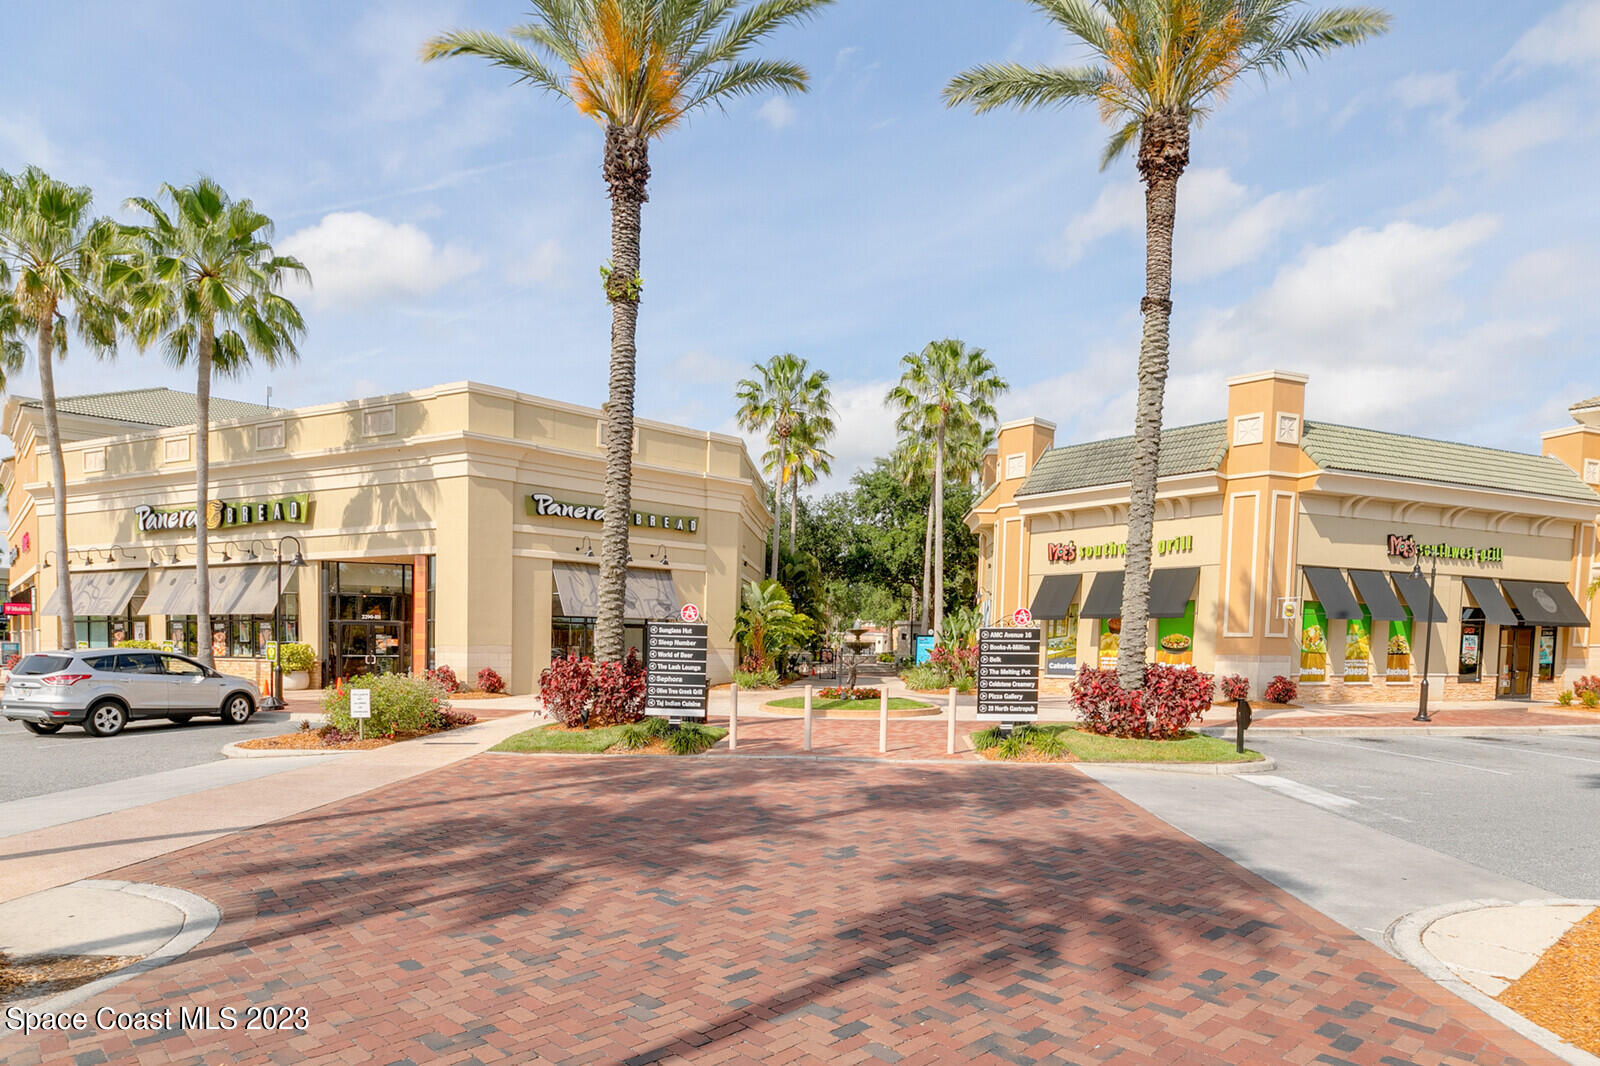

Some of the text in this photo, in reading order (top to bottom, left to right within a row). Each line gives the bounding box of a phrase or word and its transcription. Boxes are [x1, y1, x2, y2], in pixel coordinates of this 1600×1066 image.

[134, 501, 299, 531] Panera BREAD
[532, 493, 697, 532] Panera BREAD
[1078, 541, 1128, 558] southw
[1157, 535, 1193, 555] grill
[1479, 547, 1504, 563] grill
[1000, 668, 1020, 676] Melting
[1048, 662, 1076, 670] Catering
